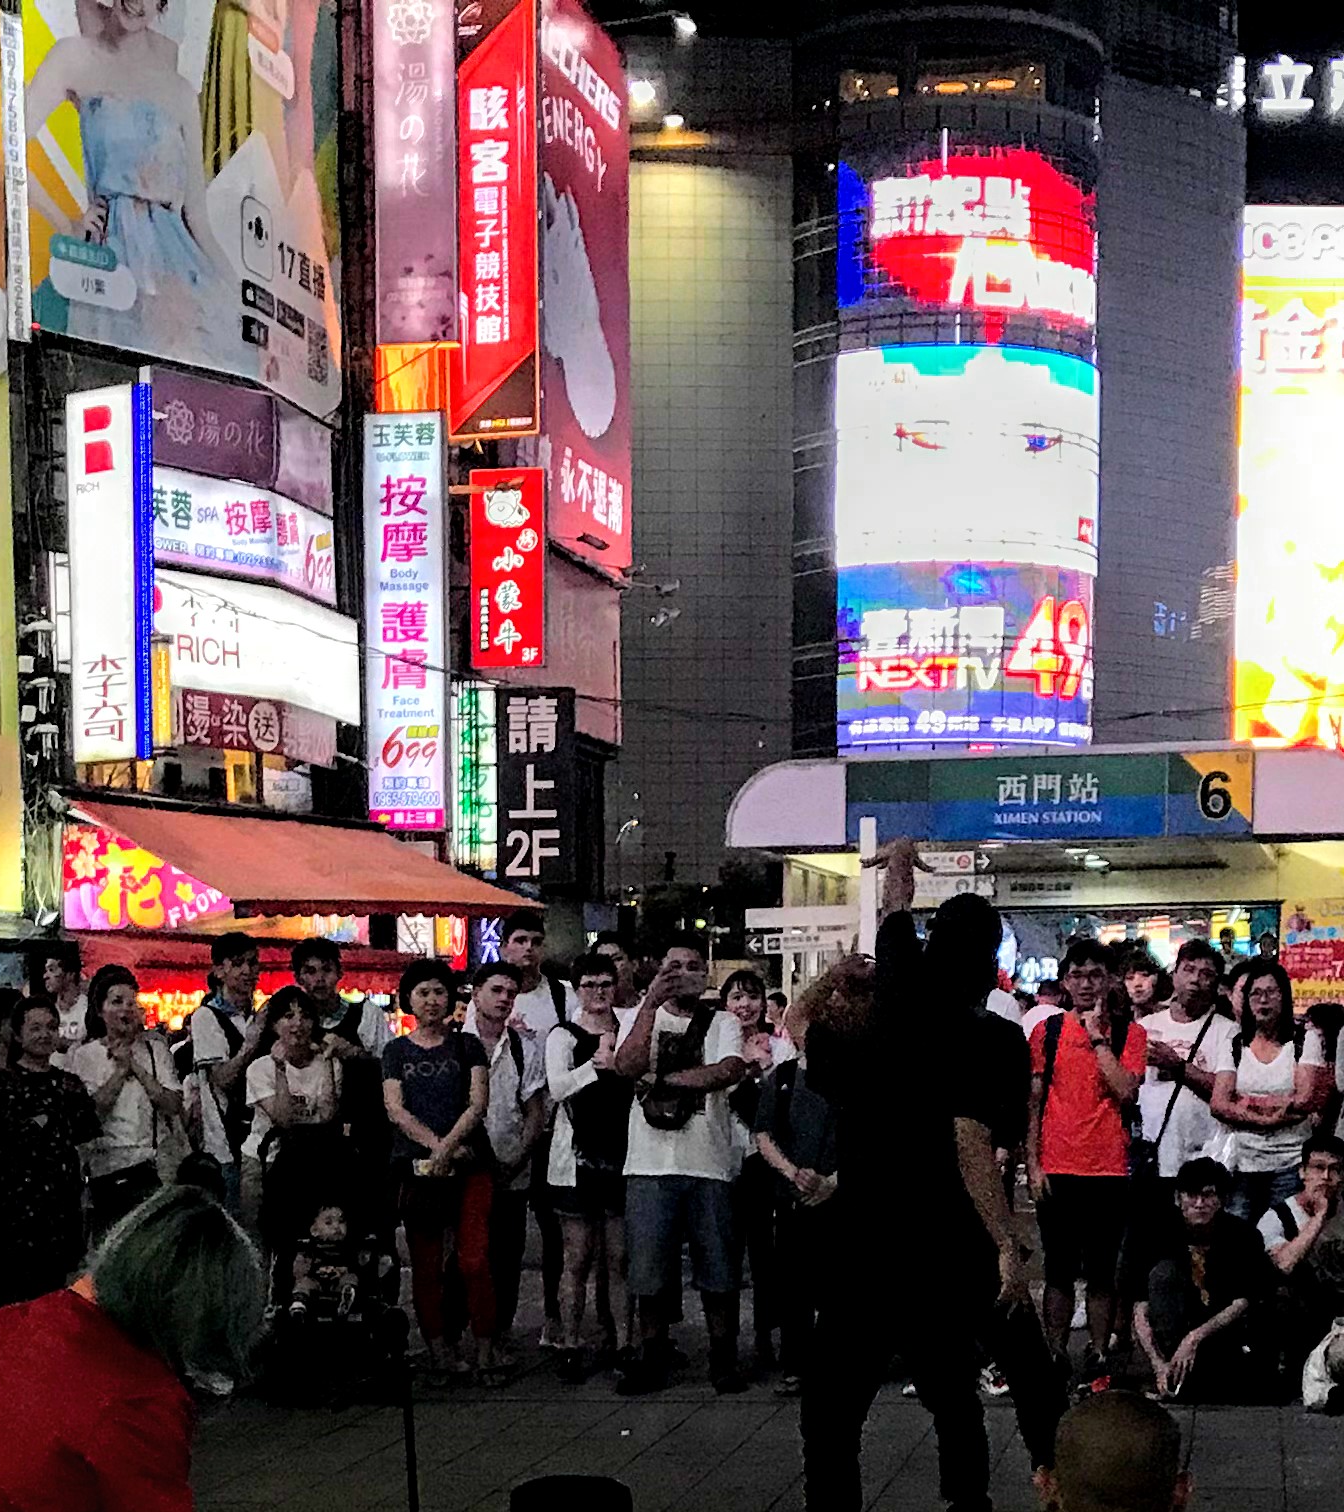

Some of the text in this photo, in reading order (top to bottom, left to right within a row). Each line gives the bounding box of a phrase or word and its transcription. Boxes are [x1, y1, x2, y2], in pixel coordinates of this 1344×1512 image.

[542, 96, 607, 193] ENERGY
[197, 408, 267, 458] 湯の花
[372, 422, 436, 448] 玉芙蓉
[197, 506, 219, 524] SPA
[224, 499, 272, 536] 按摩
[379, 473, 429, 564] 按摩
[305, 534, 334, 590] 699
[389, 568, 419, 581] Body
[379, 581, 430, 592] Massage
[492, 546, 525, 655] 小蒙牛
[177, 633, 241, 669] RICH
[380, 602, 430, 690] 護膚
[521, 647, 539, 662] 3F
[1008, 595, 1090, 701] 49
[82, 653, 128, 743] 李奇
[377, 708, 435, 719] Treatment
[392, 695, 420, 706] Face
[222, 698, 248, 746] 染
[381, 724, 438, 769] 699
[996, 772, 1100, 807] 西門站
[1198, 770, 1233, 821] 6
[993, 810, 1103, 825] XIMEN STATION
[97, 841, 165, 930] 花
